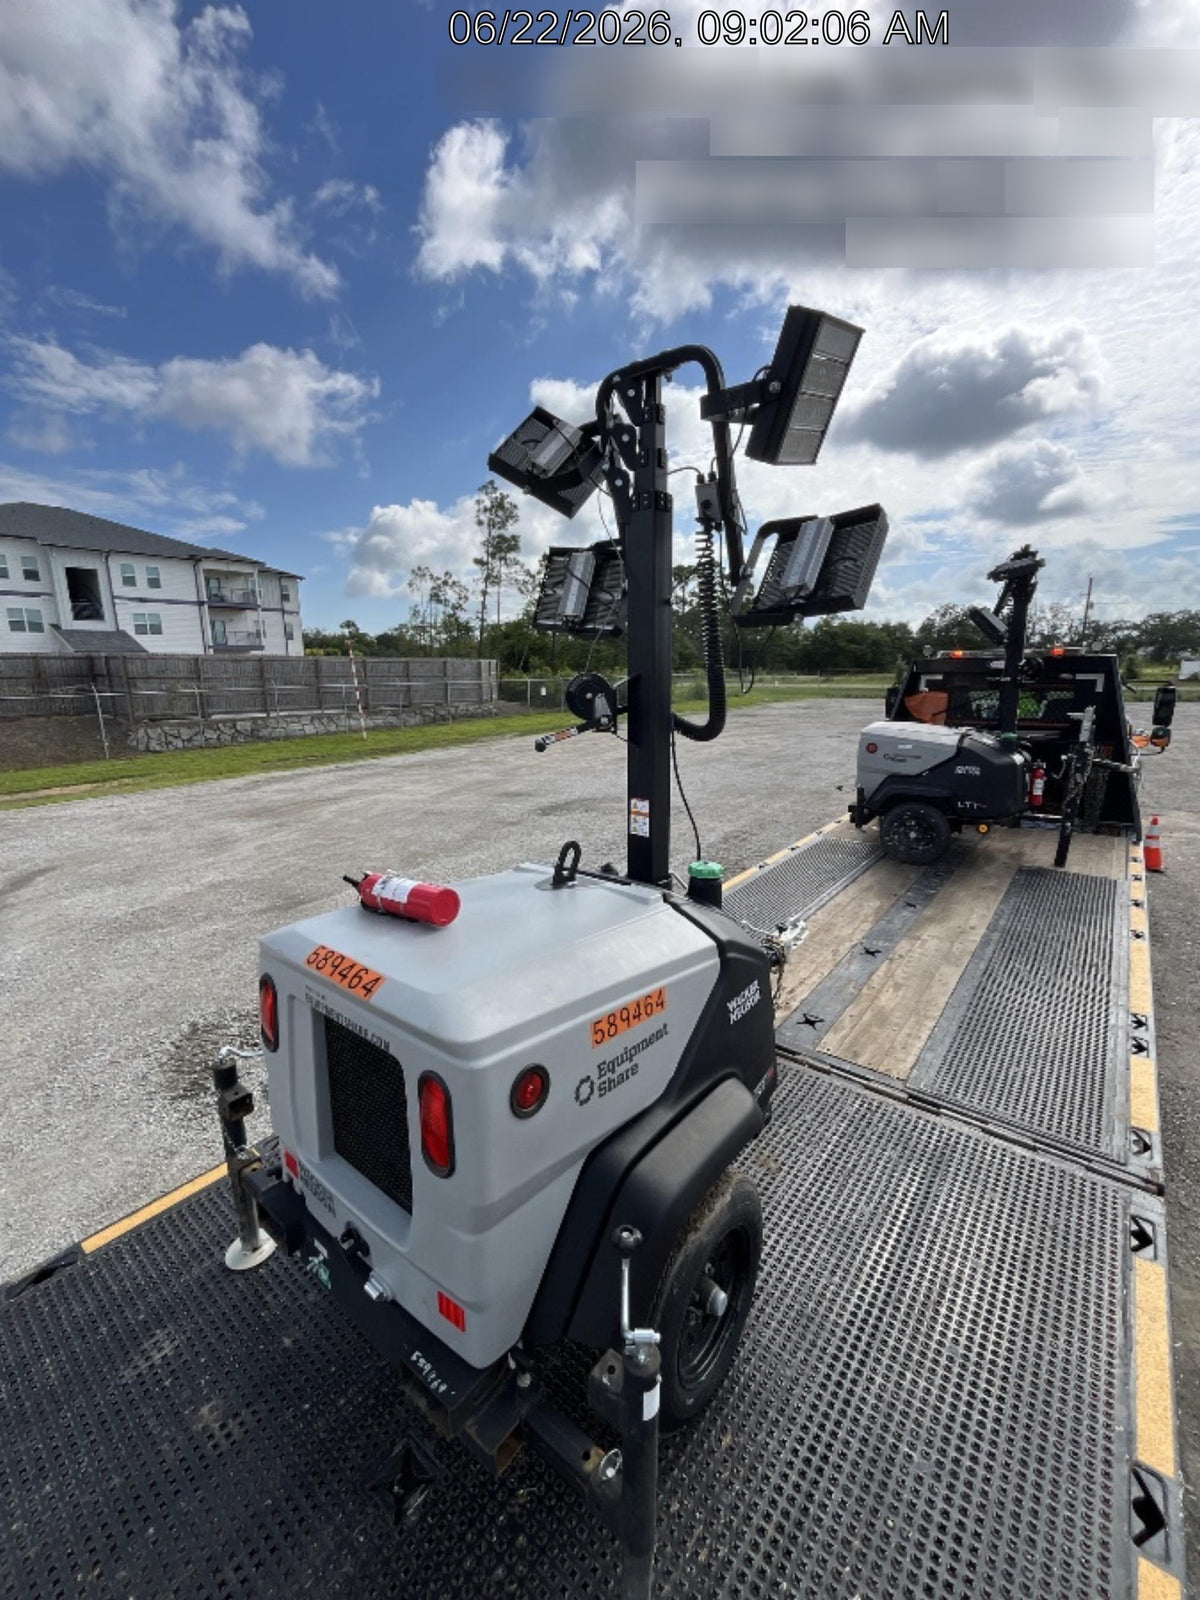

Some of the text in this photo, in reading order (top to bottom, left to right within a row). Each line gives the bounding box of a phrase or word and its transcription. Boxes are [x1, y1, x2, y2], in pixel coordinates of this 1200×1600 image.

[306, 945, 383, 998] 589464
[593, 988, 665, 1045] 589464
[597, 1022, 668, 1080] Equipment
[597, 1062, 639, 1099] Share
